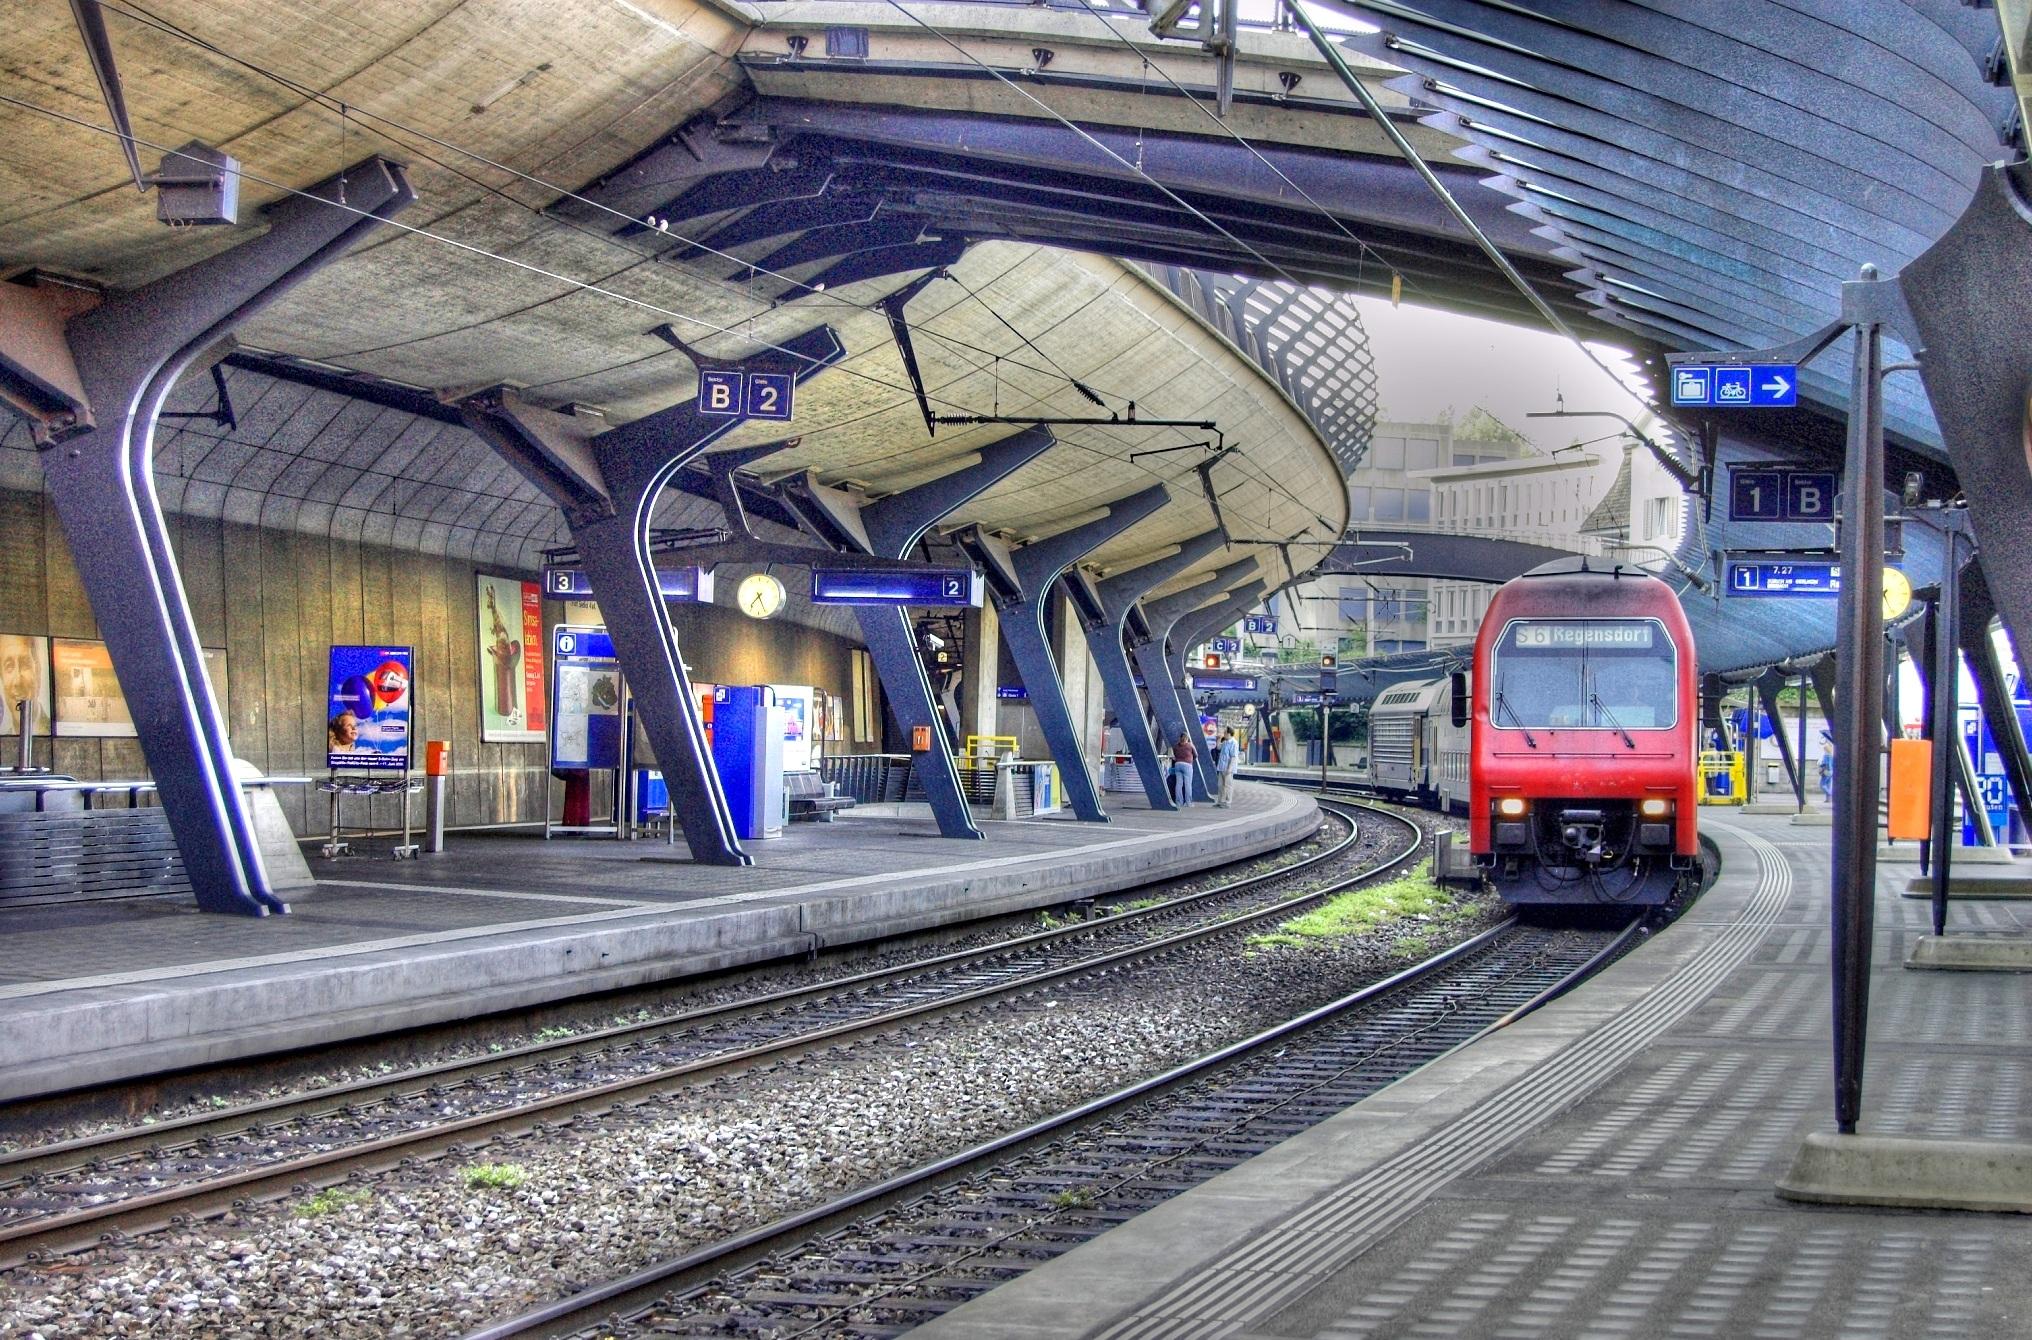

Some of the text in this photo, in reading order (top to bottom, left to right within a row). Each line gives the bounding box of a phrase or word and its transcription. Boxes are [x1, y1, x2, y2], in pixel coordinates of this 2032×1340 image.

[711, 384, 778, 411] B 2
[1749, 486, 1821, 514] 1 B
[558, 576, 569, 590] 3
[1743, 571, 1751, 587] 1
[948, 580, 959, 595] 2
[1248, 622, 1274, 632] B 2
[1518, 626, 1529, 644] S
[1534, 627, 1546, 643] 6
[1216, 642, 1238, 651] C 2
